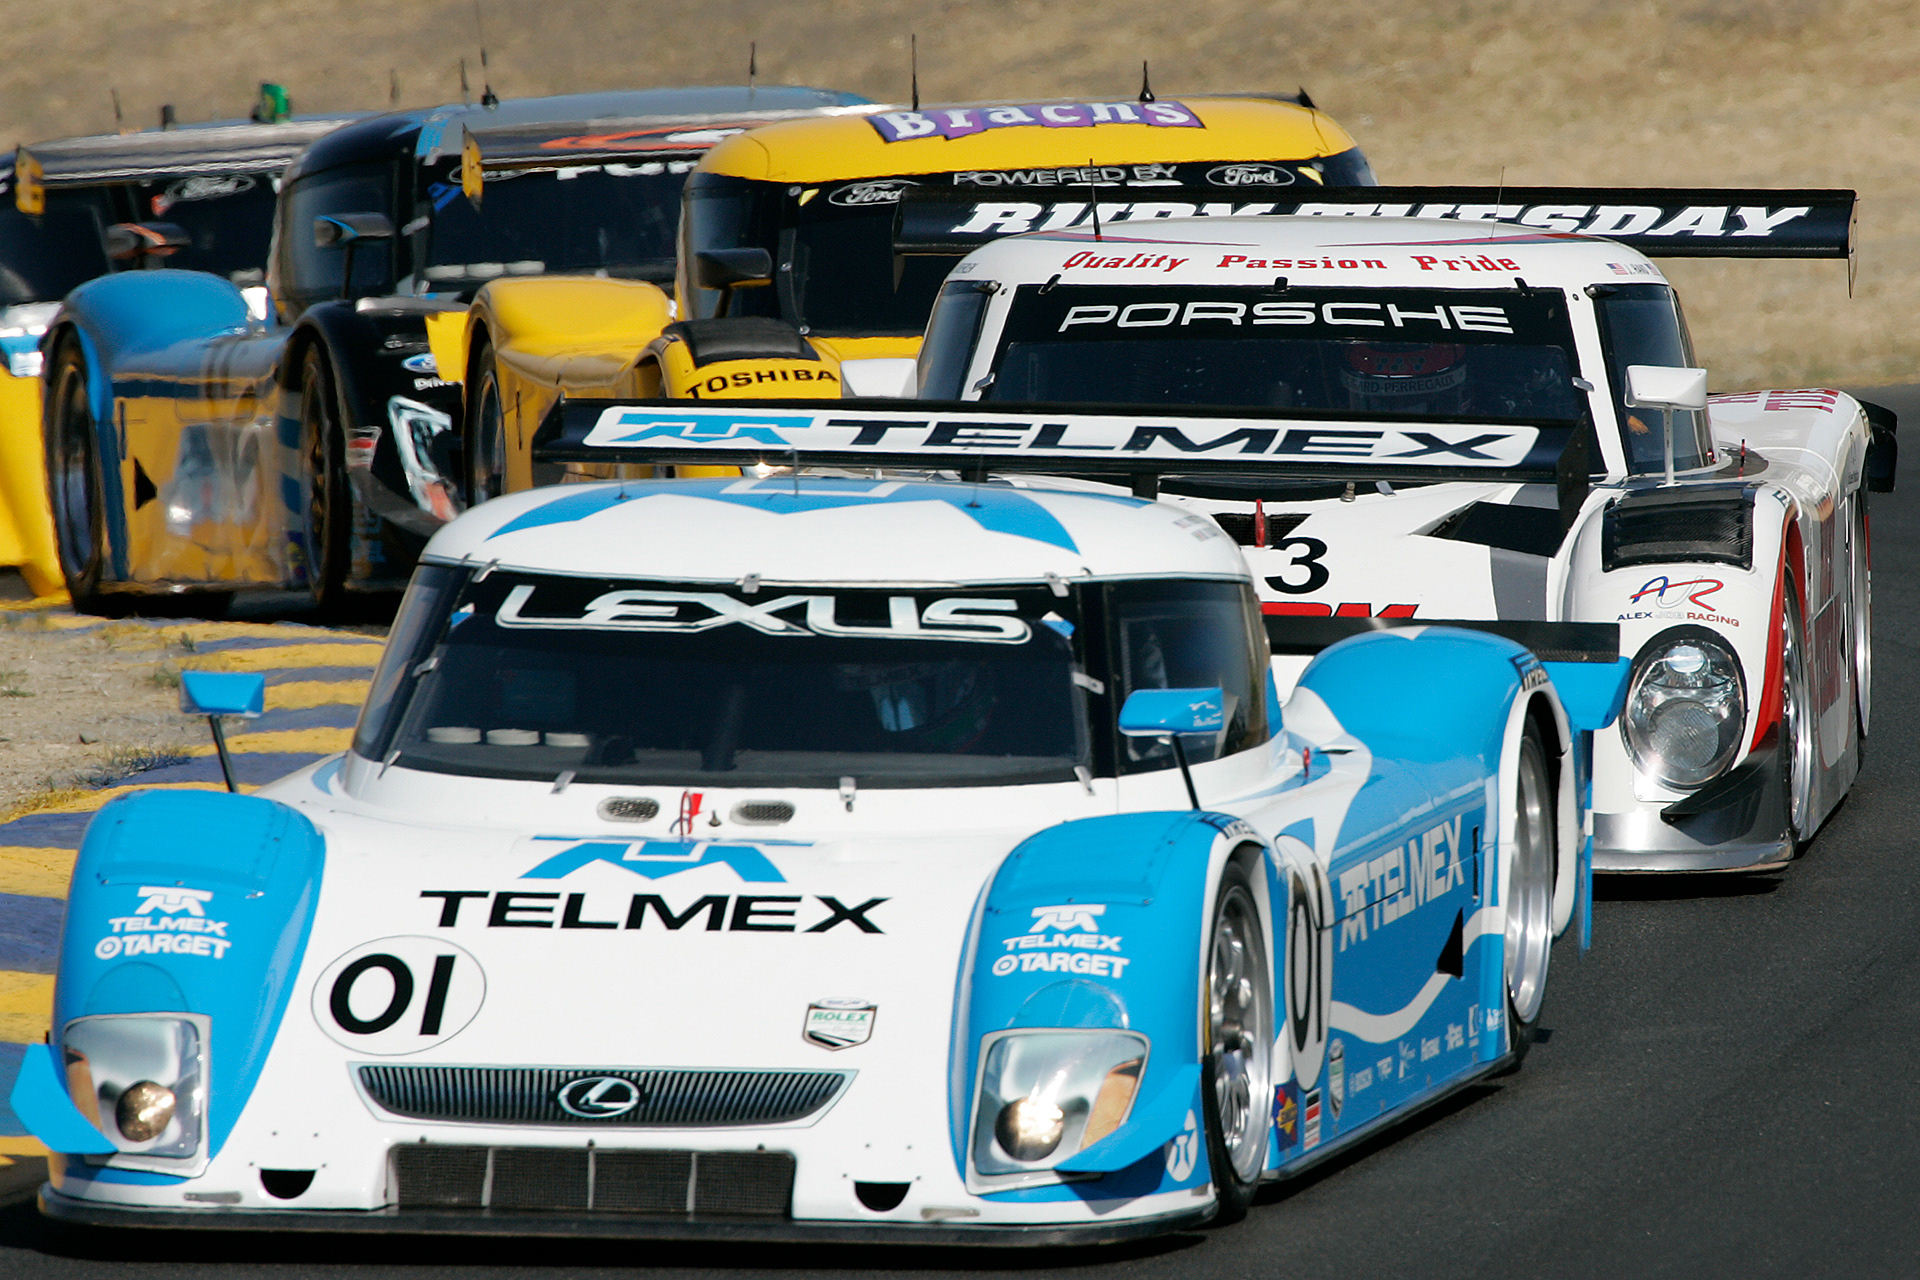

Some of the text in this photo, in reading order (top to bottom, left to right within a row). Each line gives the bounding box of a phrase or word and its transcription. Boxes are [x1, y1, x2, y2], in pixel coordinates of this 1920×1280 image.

[953, 162, 1178, 187] POWERED BY
[1062, 251, 1521, 273] Quality Passion Pride
[1058, 301, 1514, 334] PORSCHE
[685, 369, 839, 399] TOSHIBA
[826, 420, 1512, 461] TELMEX
[496, 585, 1033, 645] LEXUS
[1617, 612, 1653, 622] ALEX
[1686, 612, 1740, 627] RACING
[1368, 813, 1465, 931] TELMEX
[420, 890, 892, 934] TELMEX
[108, 917, 229, 937] TELMEX
[121, 934, 232, 960] TARGET
[1002, 933, 1123, 952] TELMEX
[1021, 952, 1131, 979] TARGET
[329, 953, 456, 1036] 01
[811, 1011, 870, 1022] ROLEX
